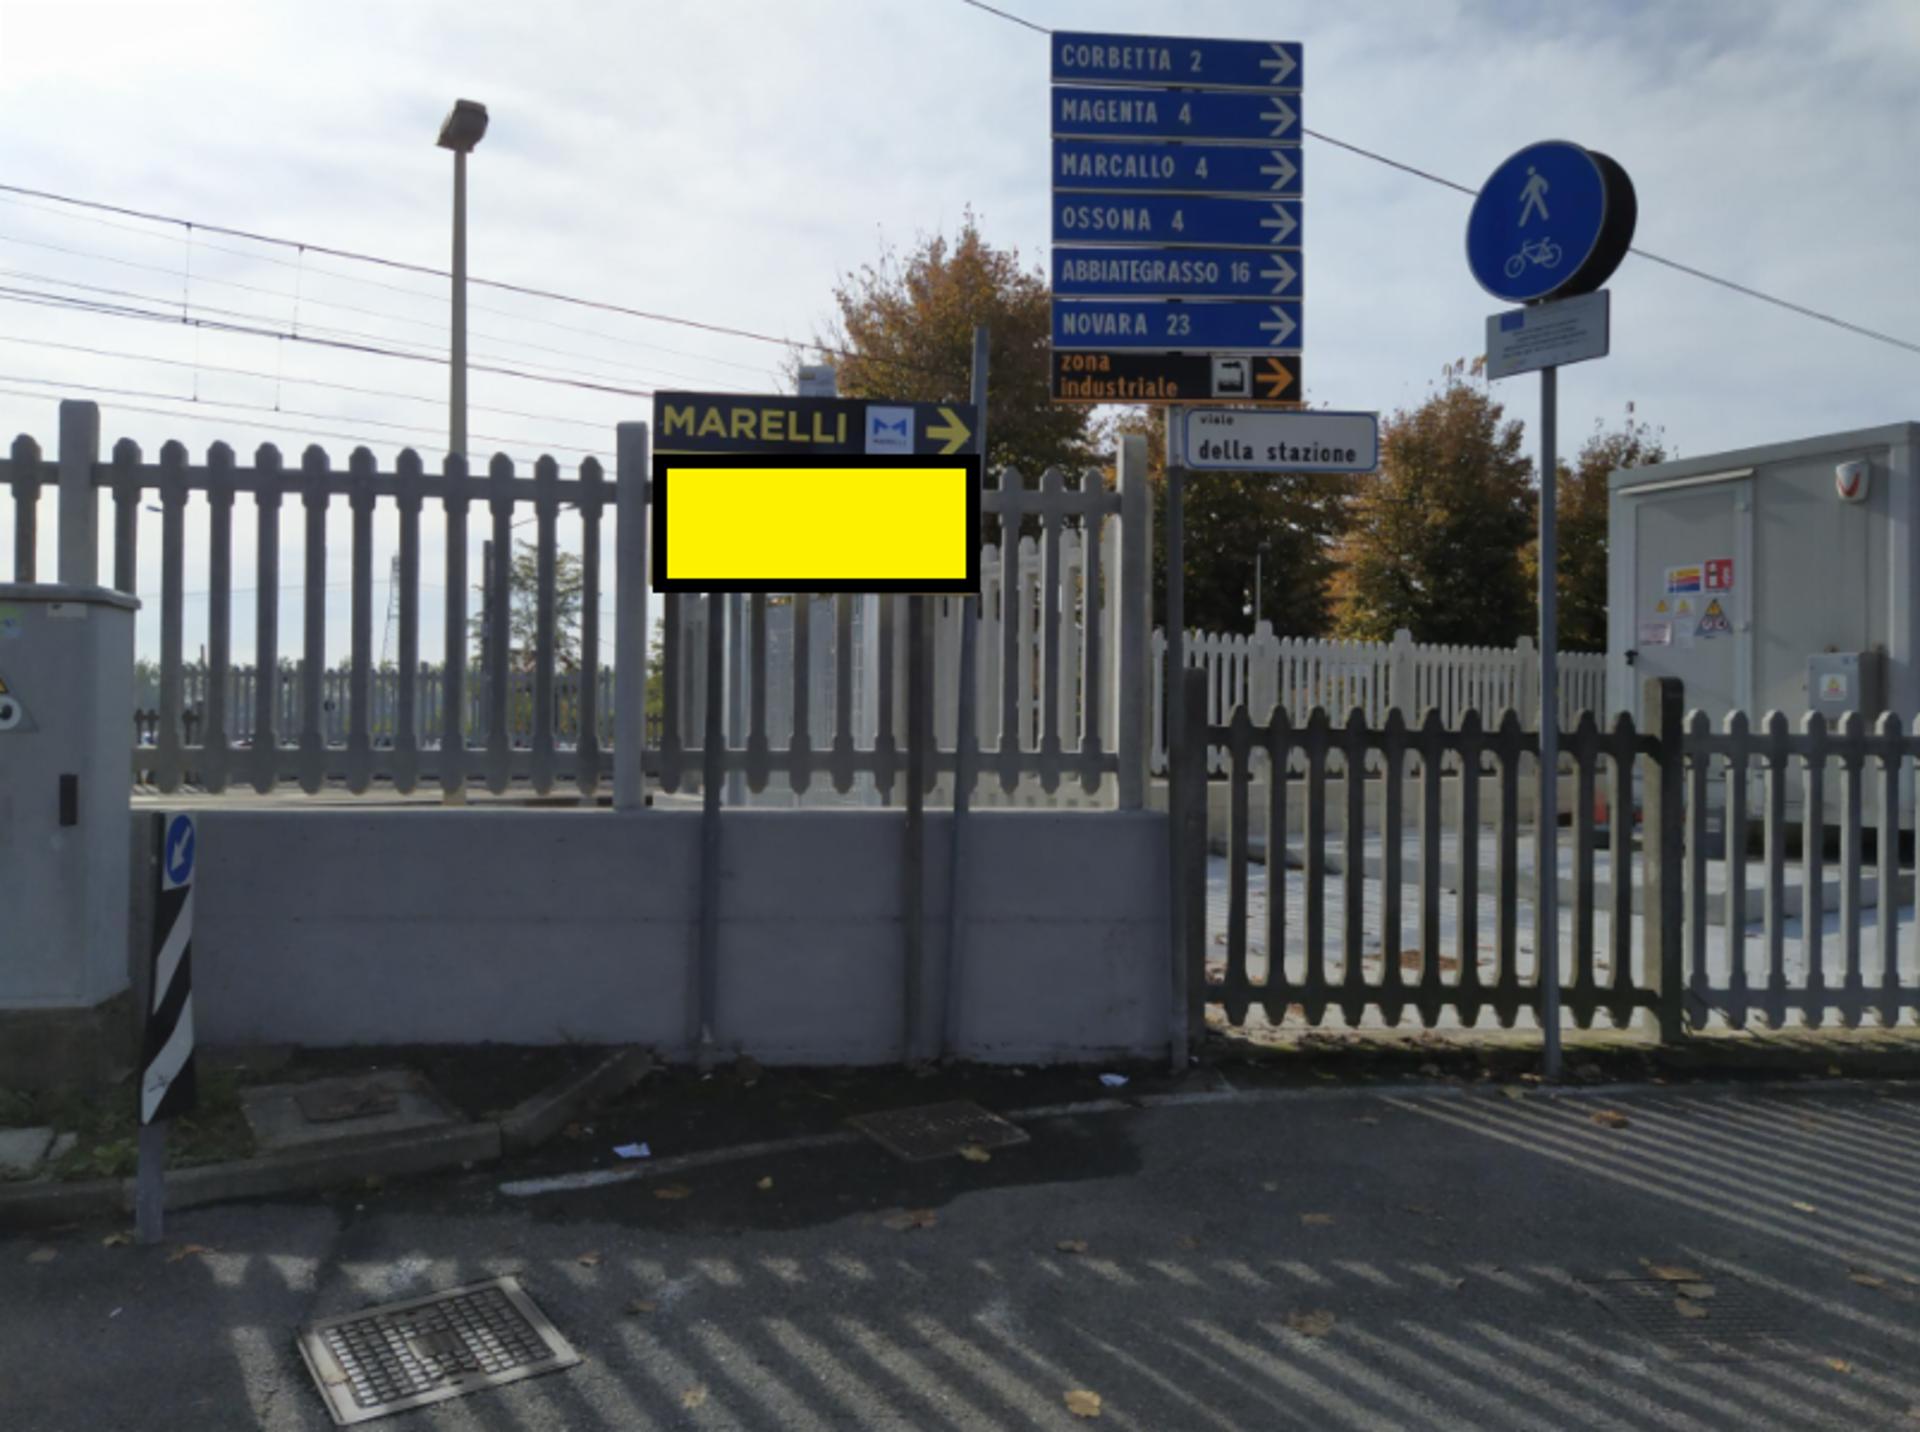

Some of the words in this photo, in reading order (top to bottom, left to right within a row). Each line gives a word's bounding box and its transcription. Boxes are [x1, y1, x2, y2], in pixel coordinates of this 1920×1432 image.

[1061, 43, 1172, 71] CORBETTA
[1189, 51, 1203, 72] 2
[1061, 98, 1158, 124] MAGENTA
[1178, 102, 1192, 125] 4
[1061, 153, 1175, 178] MARCALLO
[1195, 157, 1208, 179] 4
[1062, 206, 1151, 231] OSSONA
[1171, 210, 1185, 231] 4
[1061, 259, 1219, 283] ABBIATEGRASSO
[1231, 262, 1251, 283] 16
[1062, 313, 1148, 335] NOVARA
[1166, 314, 1191, 336] 23
[1060, 354, 1111, 371] zona
[1060, 376, 1178, 397] industriale
[663, 404, 847, 444] MARELLI
[1199, 414, 1235, 426] viale
[1199, 439, 1254, 461] della
[1267, 442, 1356, 463] stazione
